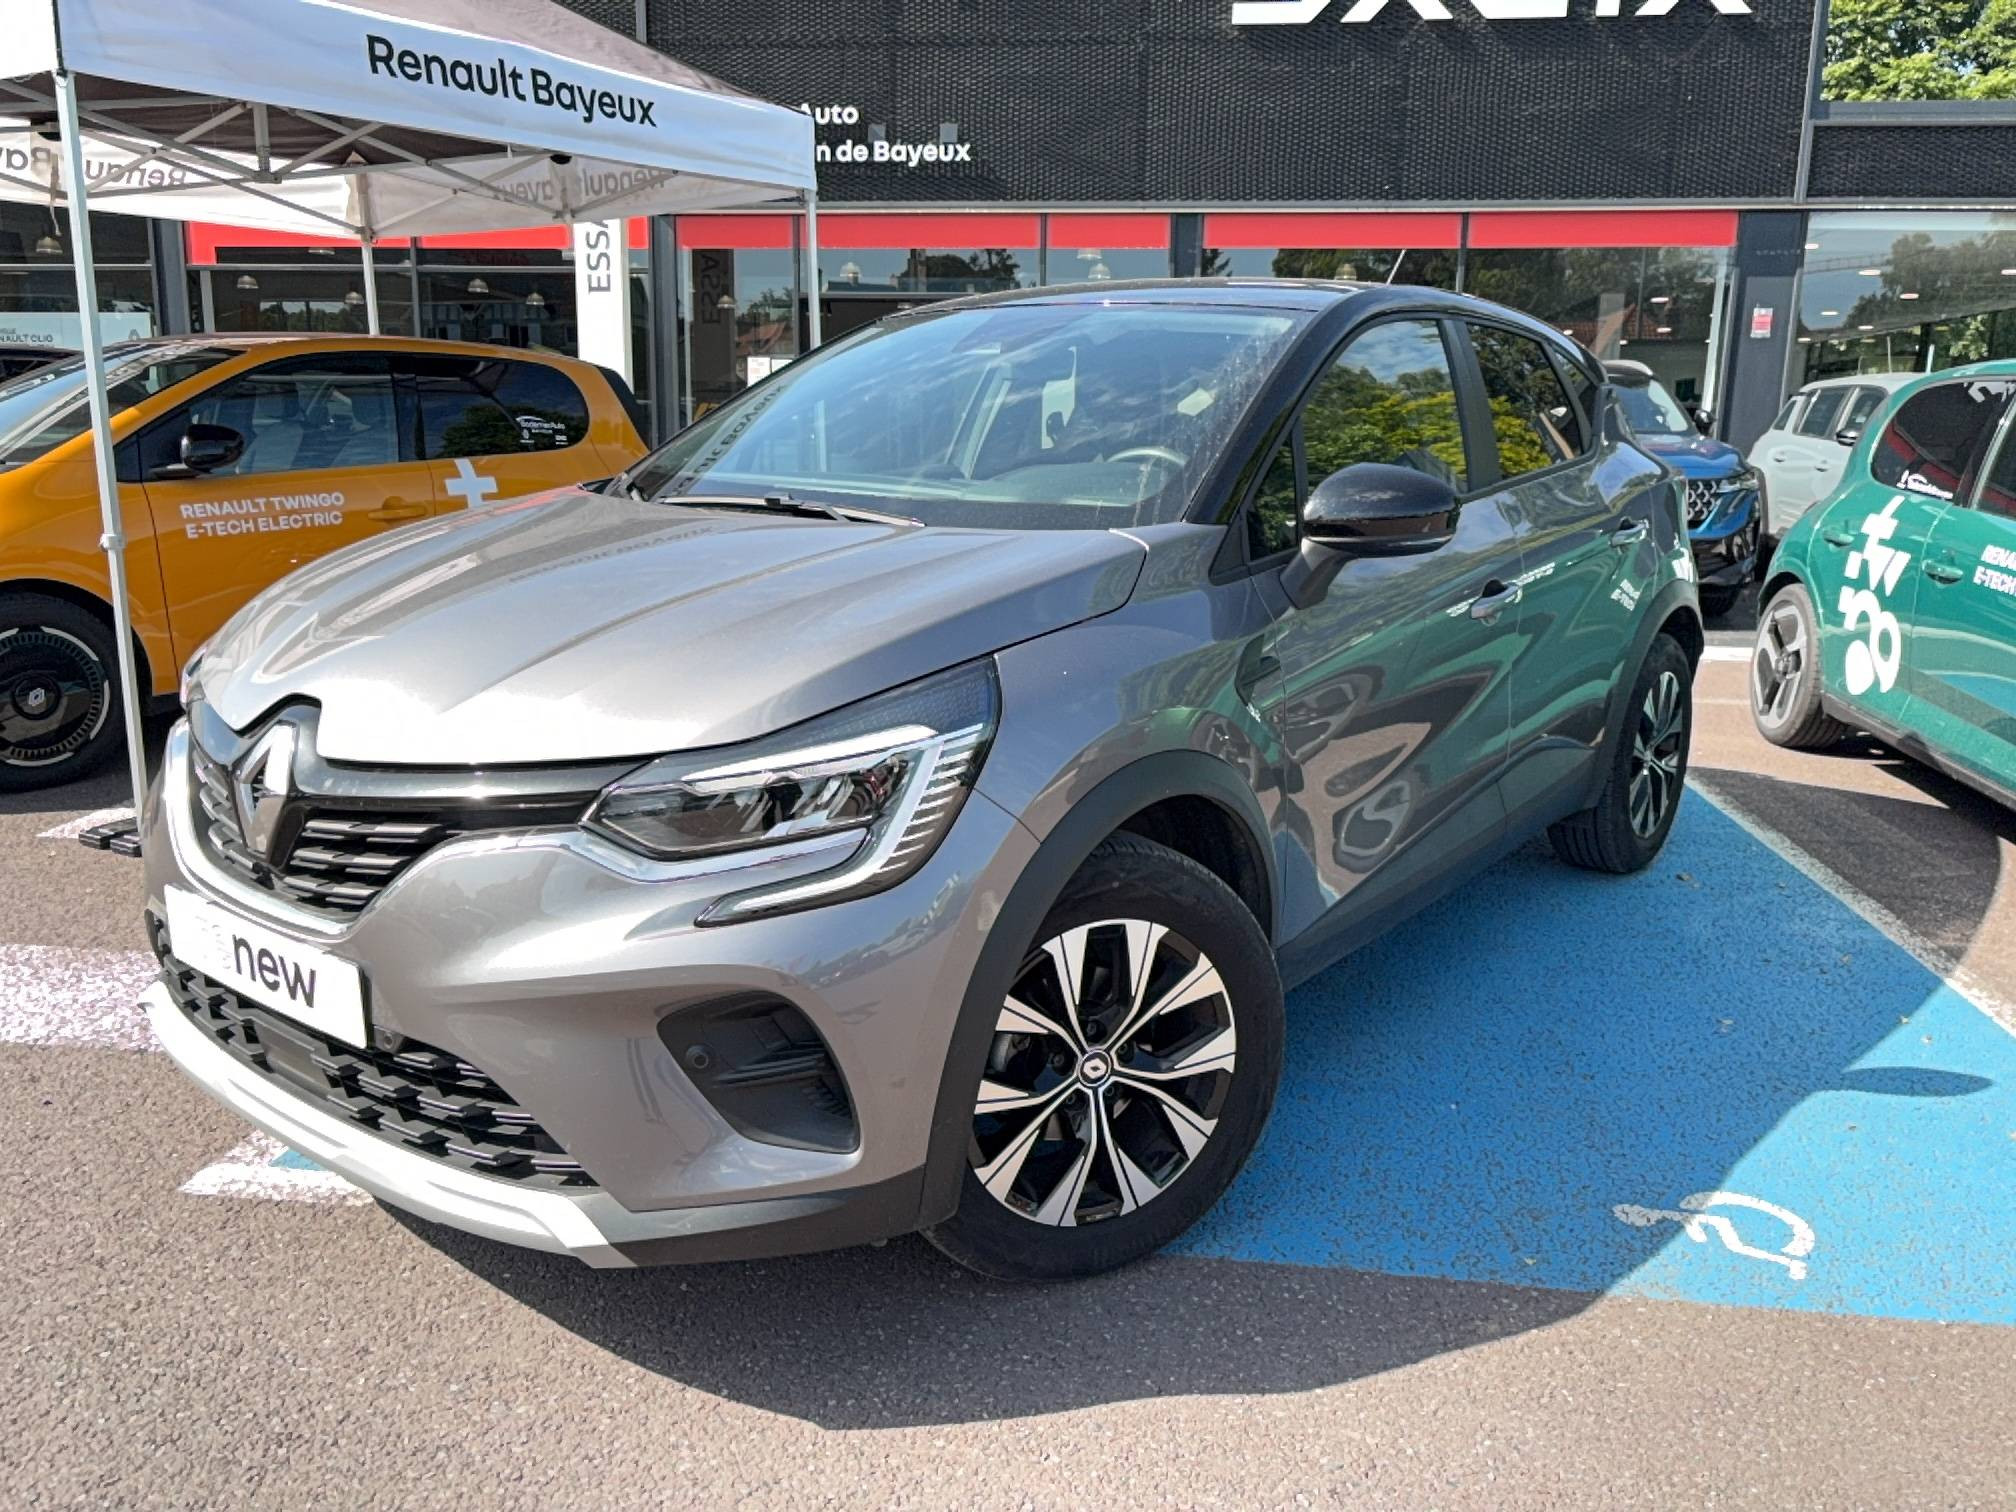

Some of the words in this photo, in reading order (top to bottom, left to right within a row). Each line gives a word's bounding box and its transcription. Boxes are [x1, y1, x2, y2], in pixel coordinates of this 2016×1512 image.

[366, 34, 527, 102] Renault
[530, 68, 657, 128] Bayeux
[835, 139, 869, 162] de
[873, 141, 972, 167] Bayeux
[180, 498, 267, 519] RENAULT
[269, 491, 345, 511] TWINGO
[185, 518, 255, 539] E-TECH
[257, 511, 343, 532] ELECTRIC
